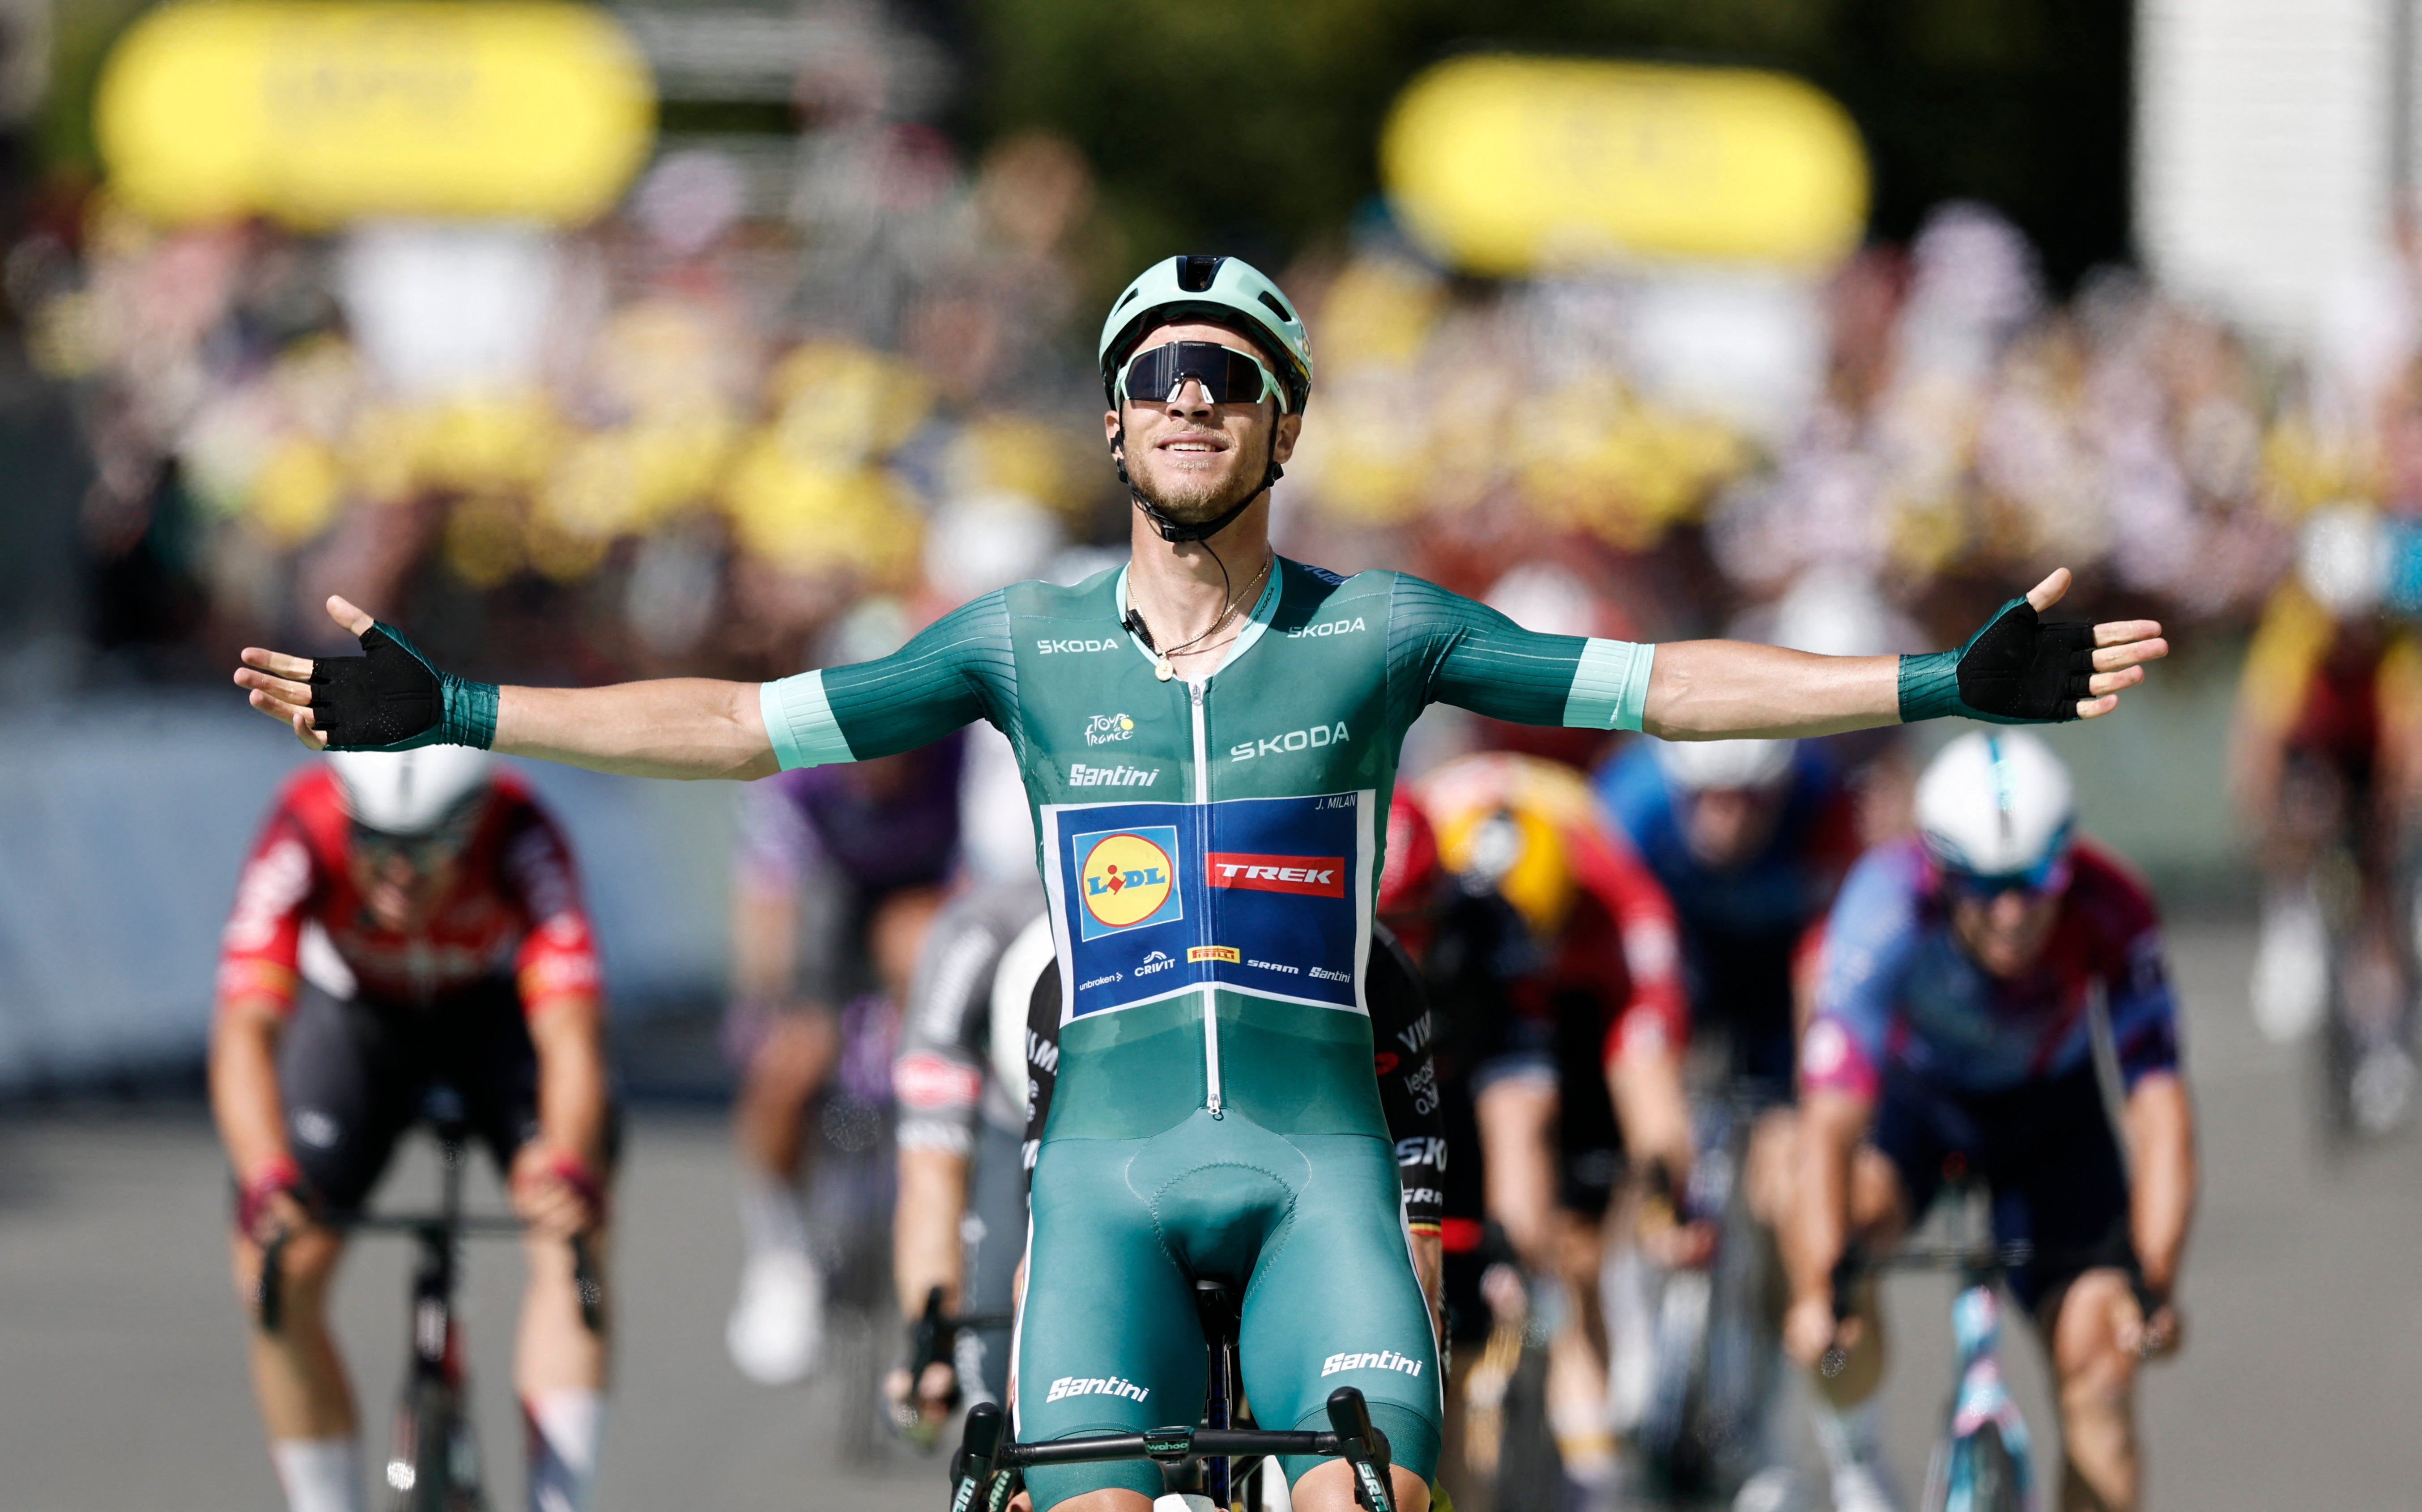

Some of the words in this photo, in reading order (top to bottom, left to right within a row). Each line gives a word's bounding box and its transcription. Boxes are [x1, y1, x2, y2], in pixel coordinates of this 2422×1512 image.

[1069, 764, 1160, 786] Santini
[1315, 798, 1324, 810] J.
[1327, 794, 1356, 809] MILAN
[1216, 863, 1334, 884] TREK
[1192, 948, 1235, 960] PIRELLI
[1134, 958, 1175, 977] CRIVIT
[1247, 959, 1298, 974] SRAM
[1308, 966, 1351, 984] Santini
[1079, 974, 1115, 991] unbroken
[1321, 1350, 1422, 1377] Santini
[1046, 1376, 1150, 1404] Santini
[1147, 1442, 1188, 1451] wahoo
